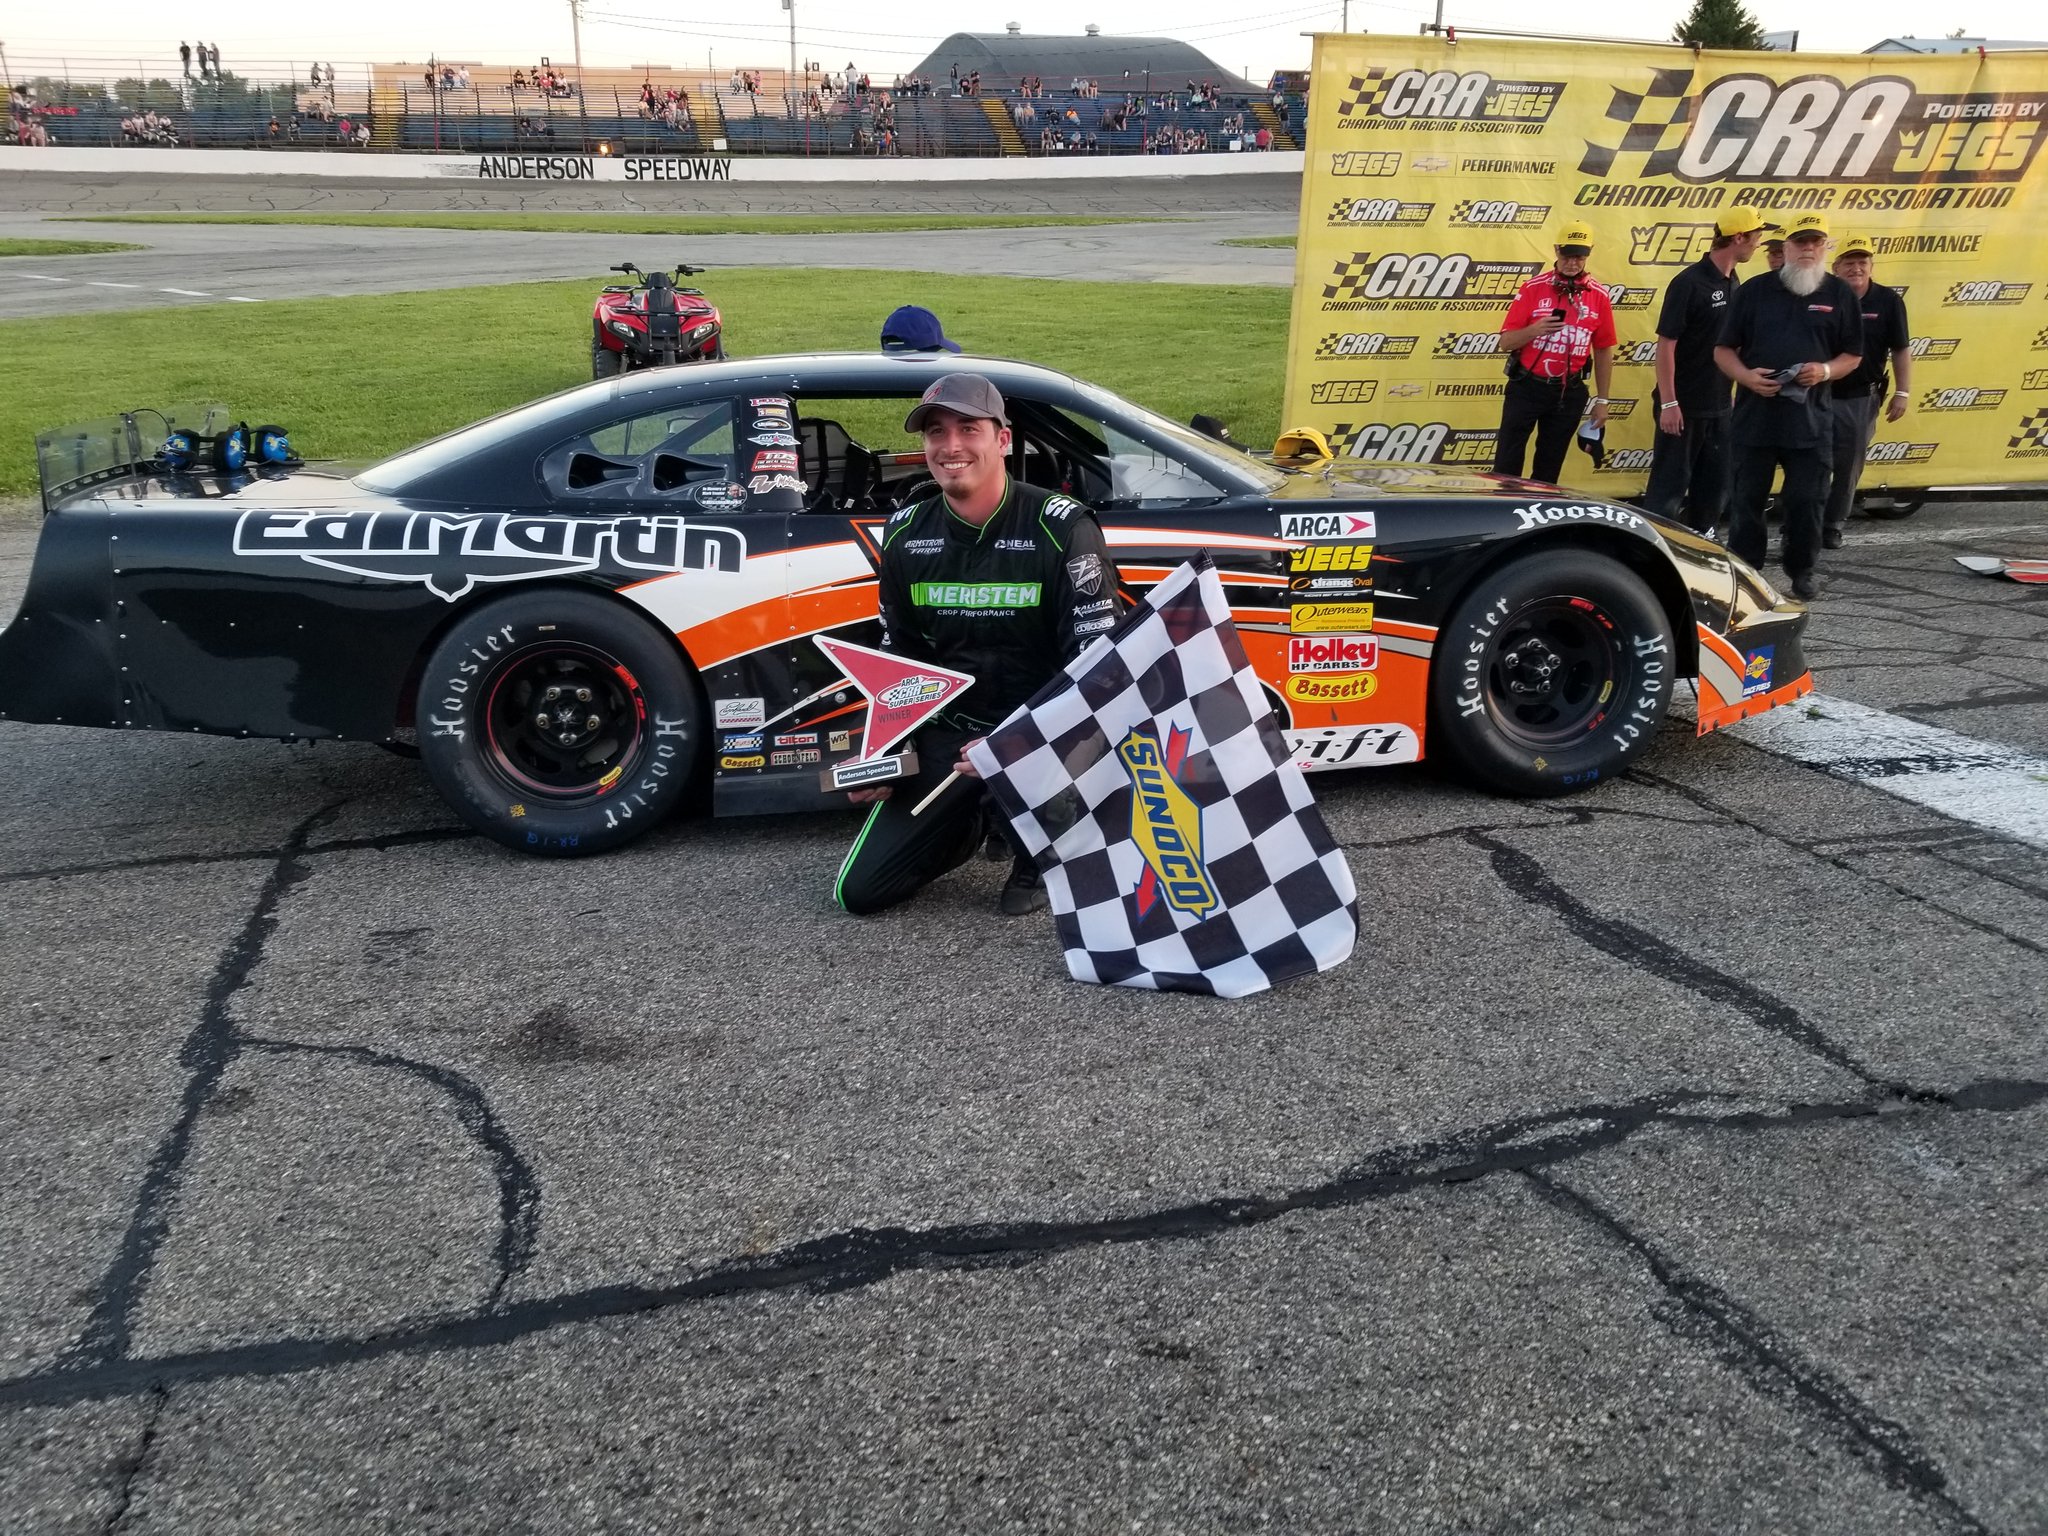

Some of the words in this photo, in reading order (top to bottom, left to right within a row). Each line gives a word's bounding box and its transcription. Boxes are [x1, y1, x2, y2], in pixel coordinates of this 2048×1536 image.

[1380, 70, 1490, 117] CRA
[1496, 83, 1540, 93] POWERED
[1484, 93, 1553, 117] JEGS
[2016, 103, 2046, 116] BY
[1337, 119, 1407, 131] CHAMPION
[1409, 121, 1456, 132] RACING
[1459, 123, 1544, 135] ASSOCIATION
[1676, 78, 1911, 178] CRA
[1893, 121, 2041, 172] JEGS
[478, 156, 594, 180] ANDERSON
[624, 158, 732, 181] SPEEDWAY
[1332, 151, 1402, 177] JEGS
[1461, 159, 1557, 175] PERFORMANCE
[1573, 184, 1726, 209] CHAMPION
[1736, 186, 1836, 210] RACING
[1838, 187, 2016, 210] ASSOCIATION
[1348, 199, 1399, 221] CRA
[1397, 208, 1430, 219] JEGS
[1467, 200, 1519, 223] CRA
[1515, 211, 1546, 222] JEGS
[1870, 235, 1983, 254] ERFORMANCE
[1364, 254, 1471, 298] CRA
[1476, 264, 1521, 273] POWERED
[1522, 265, 1534, 273] BY
[1622, 294, 1652, 303] JEGS
[1957, 281, 2003, 301] CRA
[1321, 301, 1389, 312] CHAMPION
[1391, 301, 1439, 311] RACING
[1440, 301, 1511, 312] ASSOCIATIO
[1335, 334, 1384, 354] CRA
[1381, 342, 1415, 353] JEGS
[1452, 334, 1502, 354] CRA
[1533, 339, 1588, 356] CHOCOATE
[1311, 380, 1378, 404] JEGS
[1435, 384, 1506, 396] PERFORMA
[1936, 388, 1980, 407] CRA
[1608, 403, 1633, 414] EGS
[1351, 424, 1448, 463] CRA
[1454, 432, 1497, 440] POWERED
[1866, 442, 1909, 461] CRA
[1513, 502, 1645, 530] Hoosier
[1285, 515, 1342, 538] ARCA
[1006, 539, 1036, 548] NEAL
[1290, 545, 1374, 572] JEGS
[928, 586, 1037, 604] MERISTEM
[1296, 605, 1369, 622] Outerwears
[1291, 638, 1376, 668] Holley
[1457, 597, 1507, 719] Hoosier
[1291, 663, 1309, 671] HP
[1313, 661, 1360, 670] CARBS
[429, 624, 516, 743] Hoosier
[901, 677, 920, 687] ARCA
[1296, 677, 1368, 698] Bassett
[889, 698, 914, 708] SUPER
[915, 691, 941, 702] SERIES
[898, 685, 922, 700] CRA
[1612, 633, 1668, 752] Hoosier
[878, 709, 912, 723] WINNER
[778, 735, 816, 745] tilton
[830, 732, 848, 745] WIX
[602, 712, 688, 828] Hoosier
[724, 757, 762, 767] Bassett
[838, 770, 867, 781] Anderson
[866, 764, 897, 776] Speedway
[1124, 742, 1210, 904] SUNOCO
